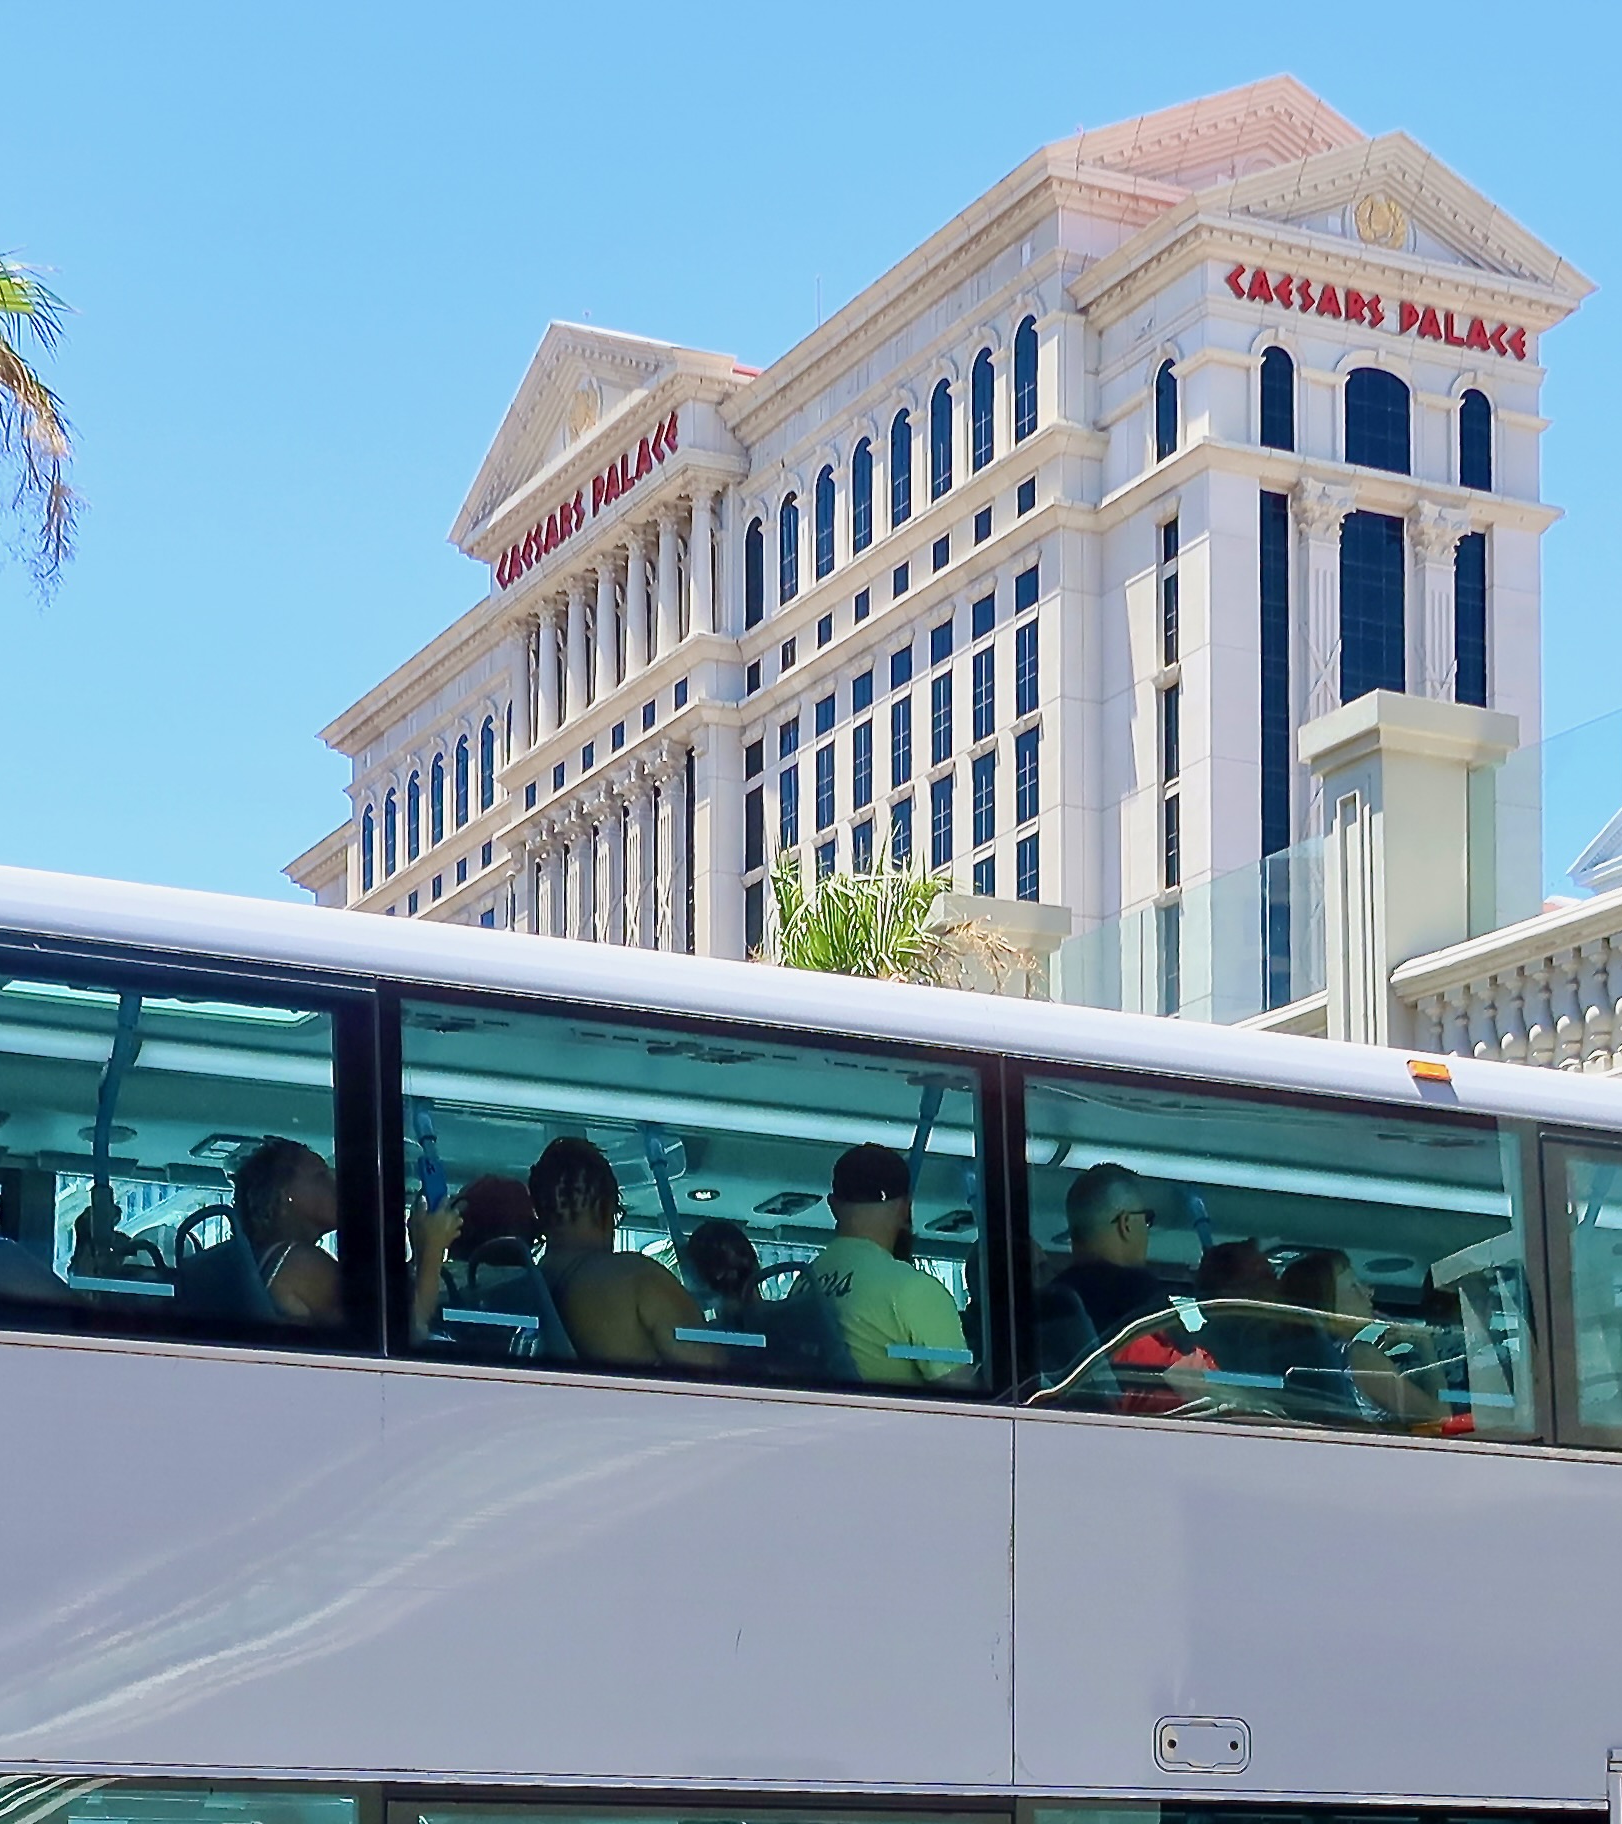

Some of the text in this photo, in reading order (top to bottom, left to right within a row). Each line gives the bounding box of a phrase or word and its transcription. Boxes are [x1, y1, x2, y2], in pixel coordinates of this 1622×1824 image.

[1225, 264, 1526, 361] CAESARS PALACE
[495, 410, 679, 591] CAESARS PALACE
